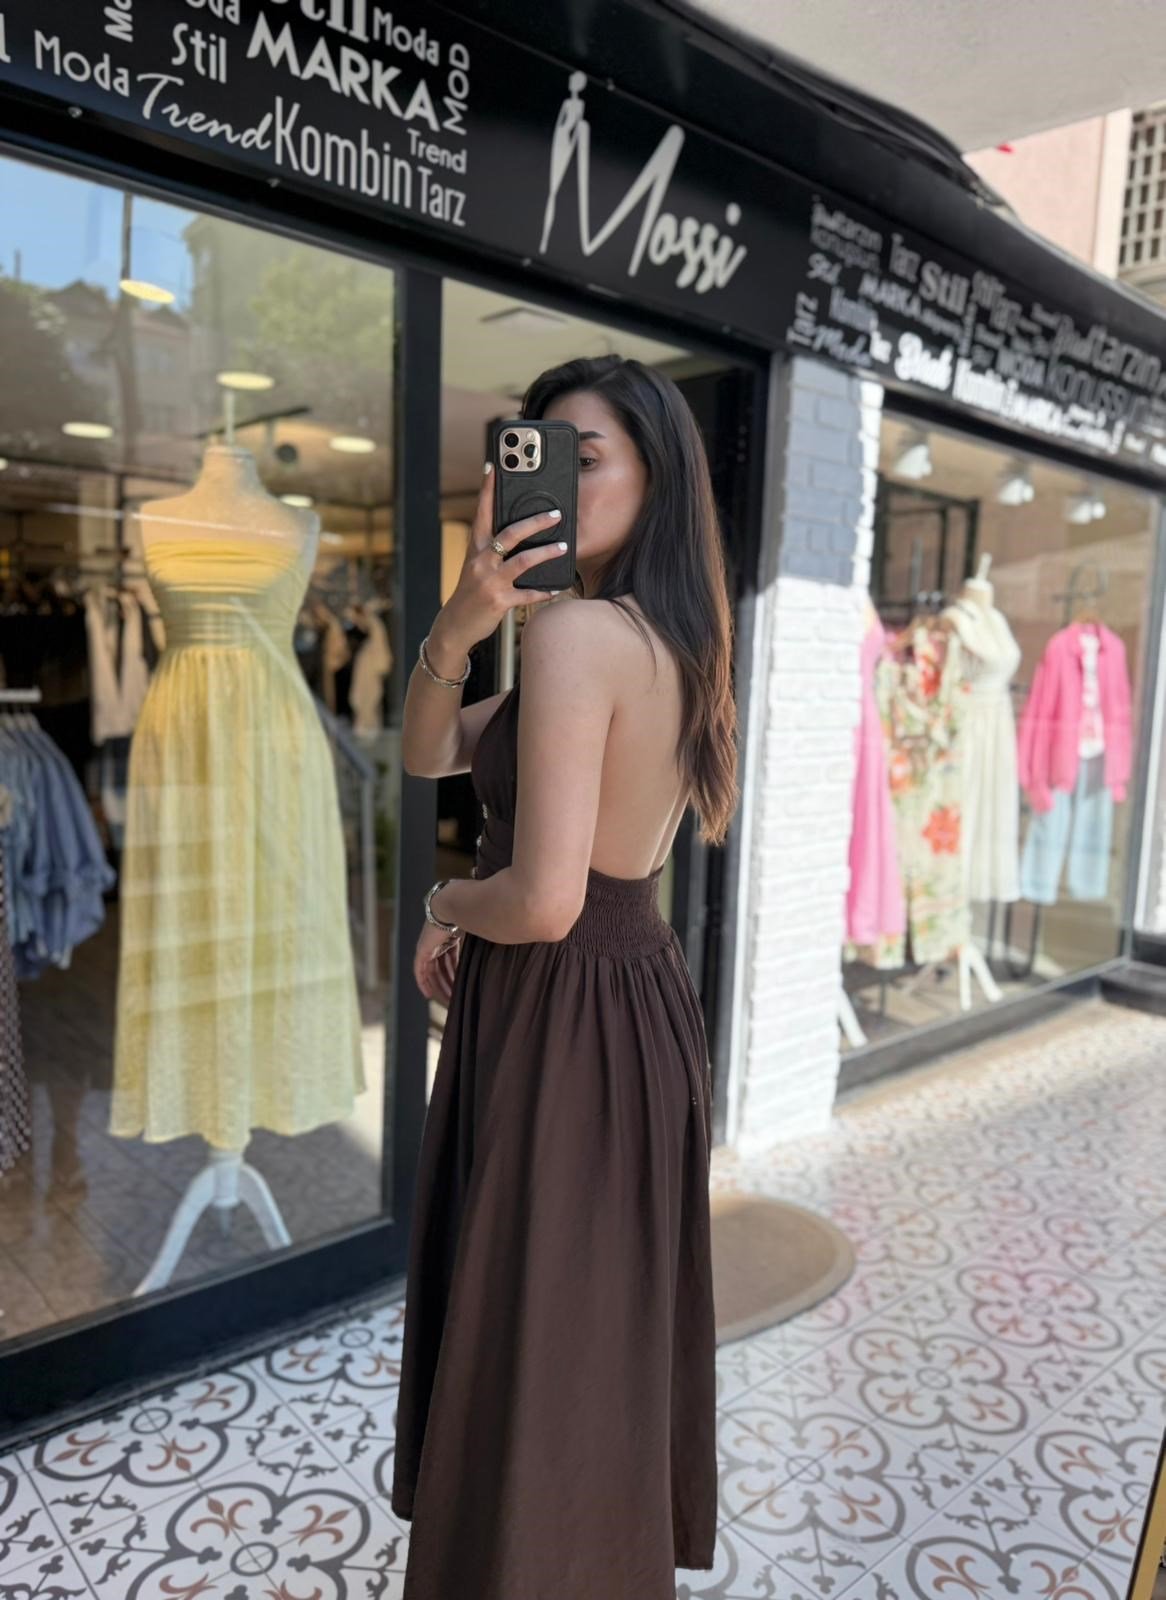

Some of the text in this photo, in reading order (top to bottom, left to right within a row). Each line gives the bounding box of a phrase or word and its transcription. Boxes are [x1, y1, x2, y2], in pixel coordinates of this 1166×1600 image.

[34, 29, 130, 97] Moda
[171, 22, 227, 84] Stil
[246, 11, 441, 131] MARKA
[373, 6, 440, 67] Moda
[136, 73, 273, 151] Trend
[443, 43, 470, 135] MOD
[274, 96, 412, 208] Kombin
[407, 129, 467, 174] Trend
[538, 70, 748, 294] Mossi
[417, 166, 467, 227] Tarz
